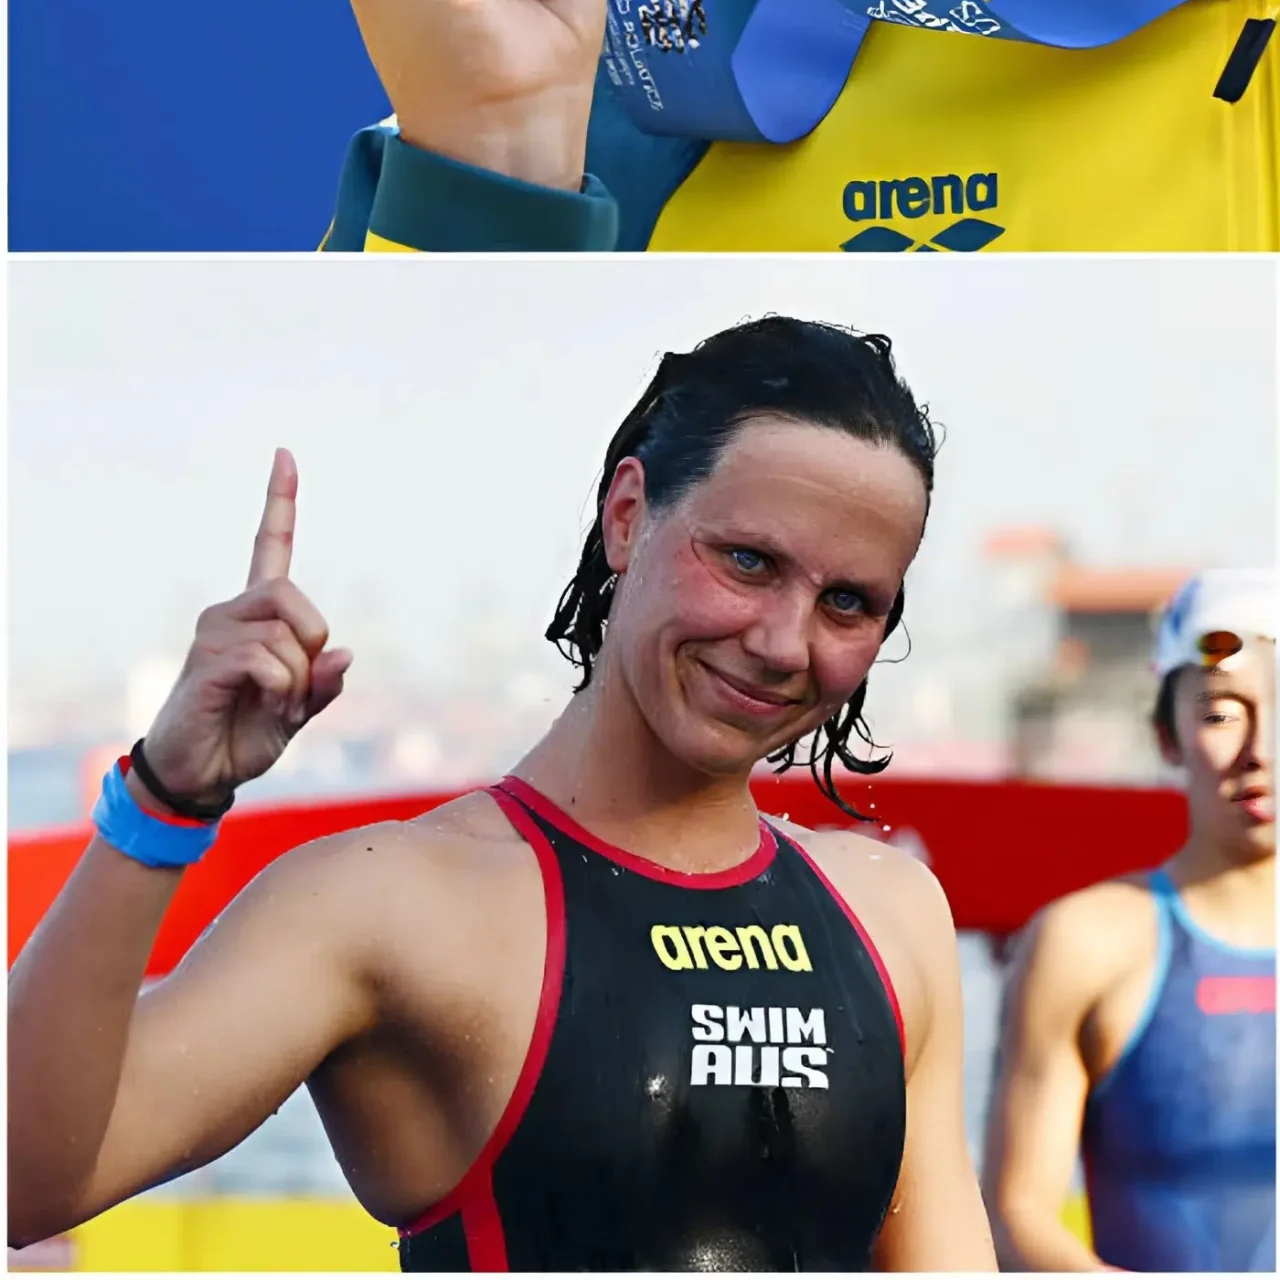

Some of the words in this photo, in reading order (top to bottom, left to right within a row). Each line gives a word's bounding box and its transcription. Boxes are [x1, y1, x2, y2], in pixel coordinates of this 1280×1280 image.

[843, 173, 998, 221] arena
[651, 924, 813, 972] arena
[691, 1004, 827, 1044] SWIM
[690, 1044, 829, 1089] AUS
